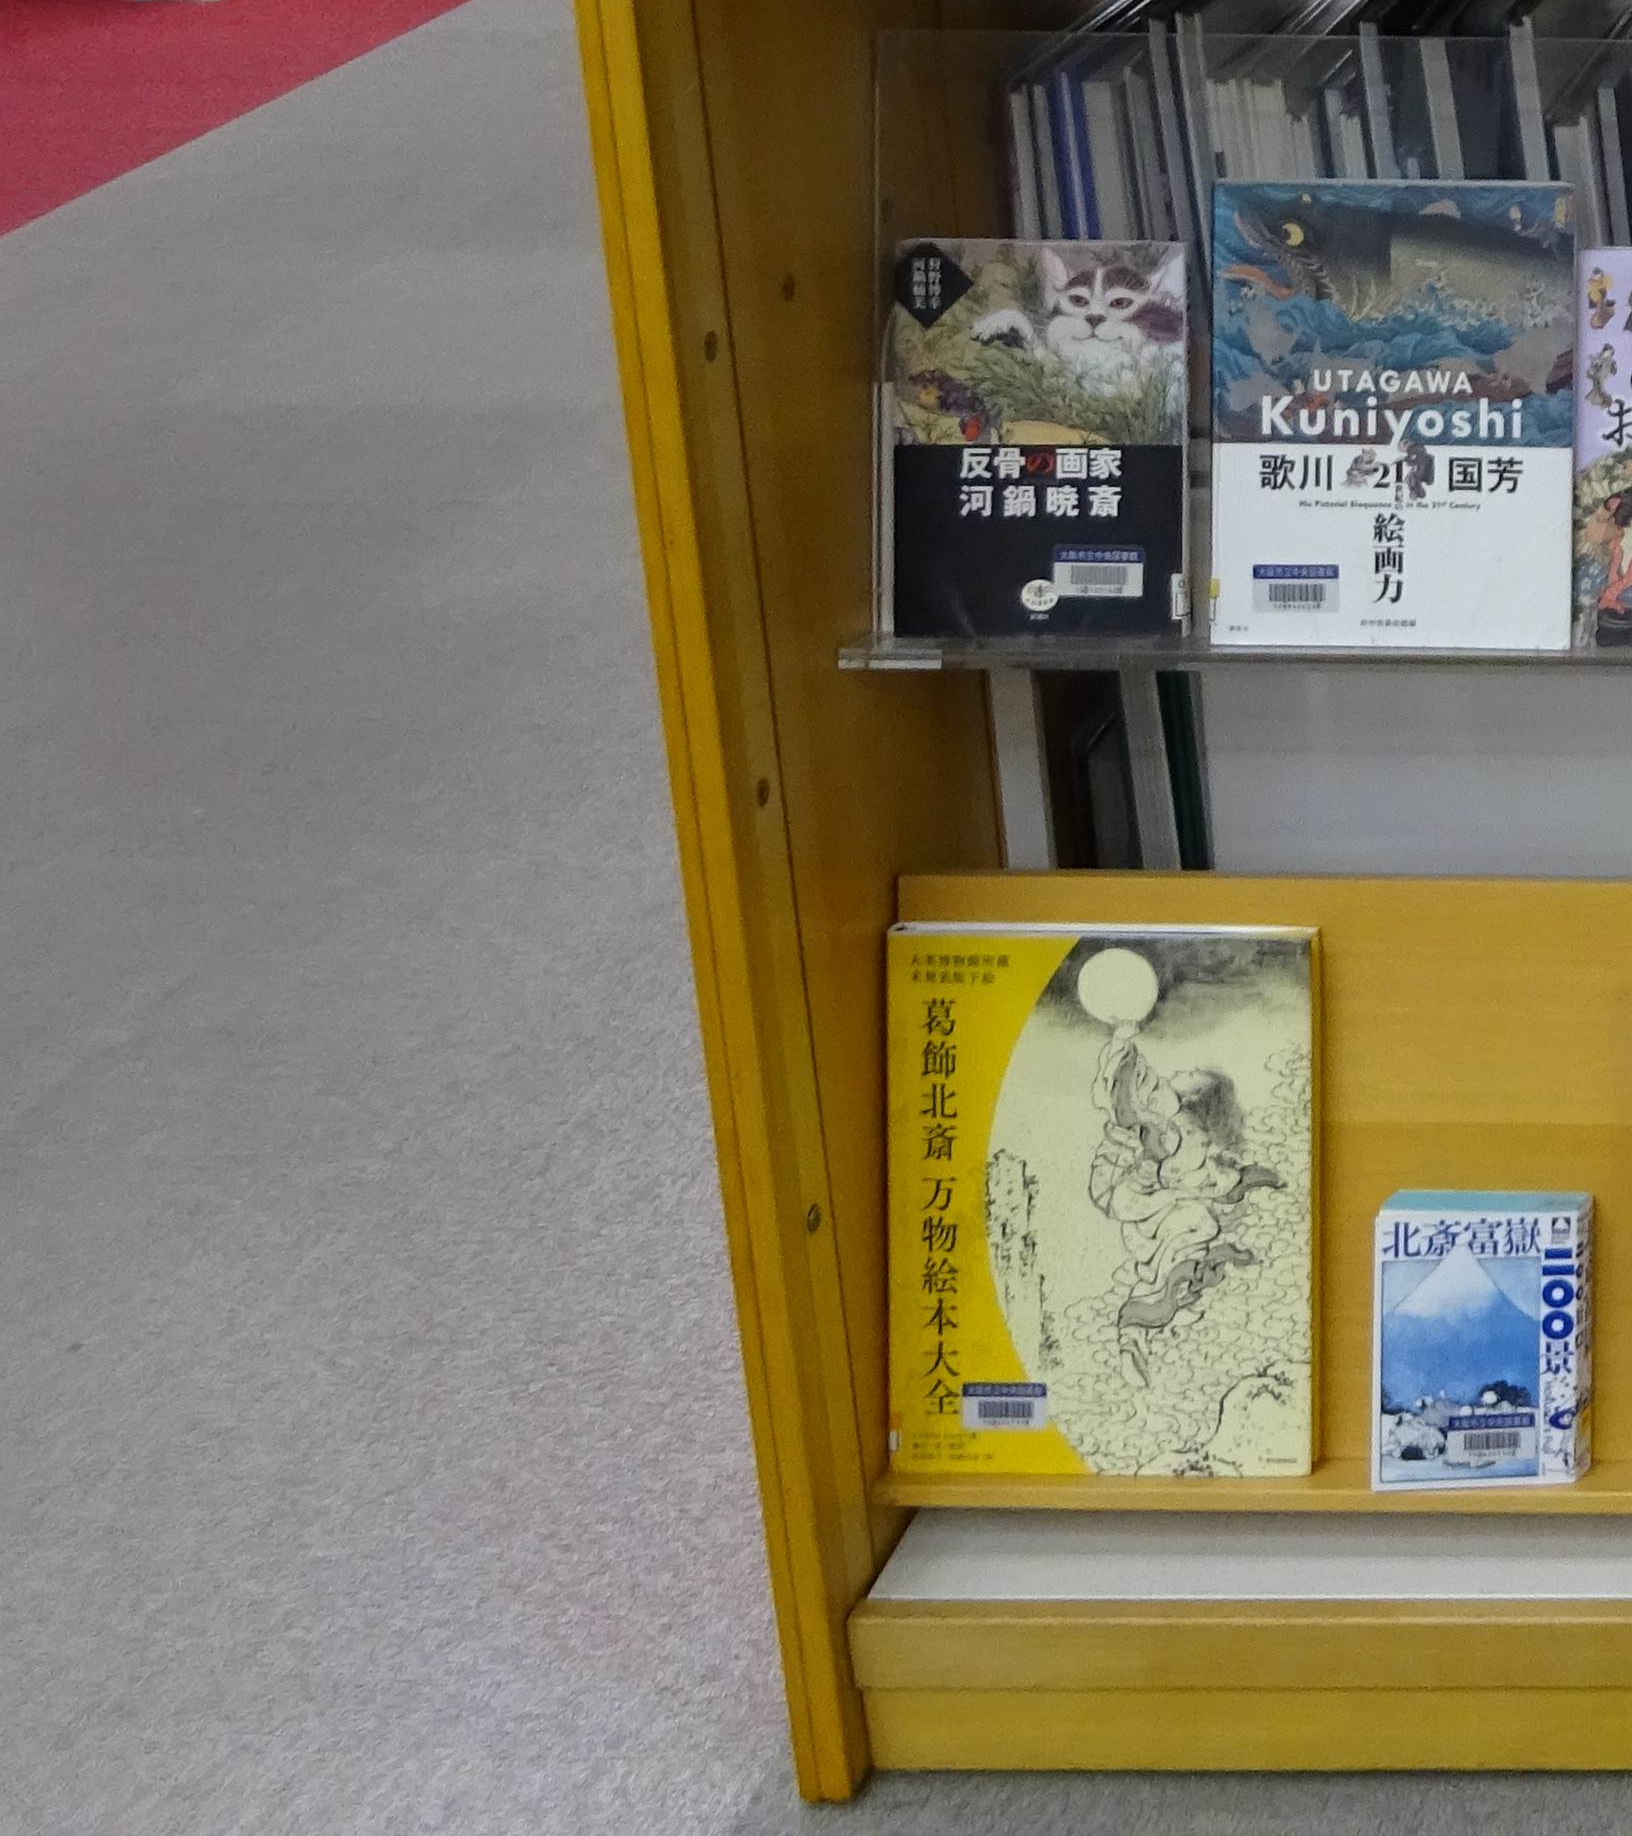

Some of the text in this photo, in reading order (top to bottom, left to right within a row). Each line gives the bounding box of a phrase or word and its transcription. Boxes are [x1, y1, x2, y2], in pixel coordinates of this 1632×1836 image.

[1312, 368, 1475, 395] UTAGAWA
[1260, 394, 1524, 446] Kuniyoshi
[959, 447, 1123, 481] 反骨の画家
[1258, 453, 1525, 495] 歌川 国芳
[959, 484, 1123, 518] 河鍋暁斎
[920, 998, 960, 1162] 葛飾北斎
[1381, 1217, 1542, 1260] 北斎富嶽
[920, 1174, 961, 1419] 万物絵本大全
